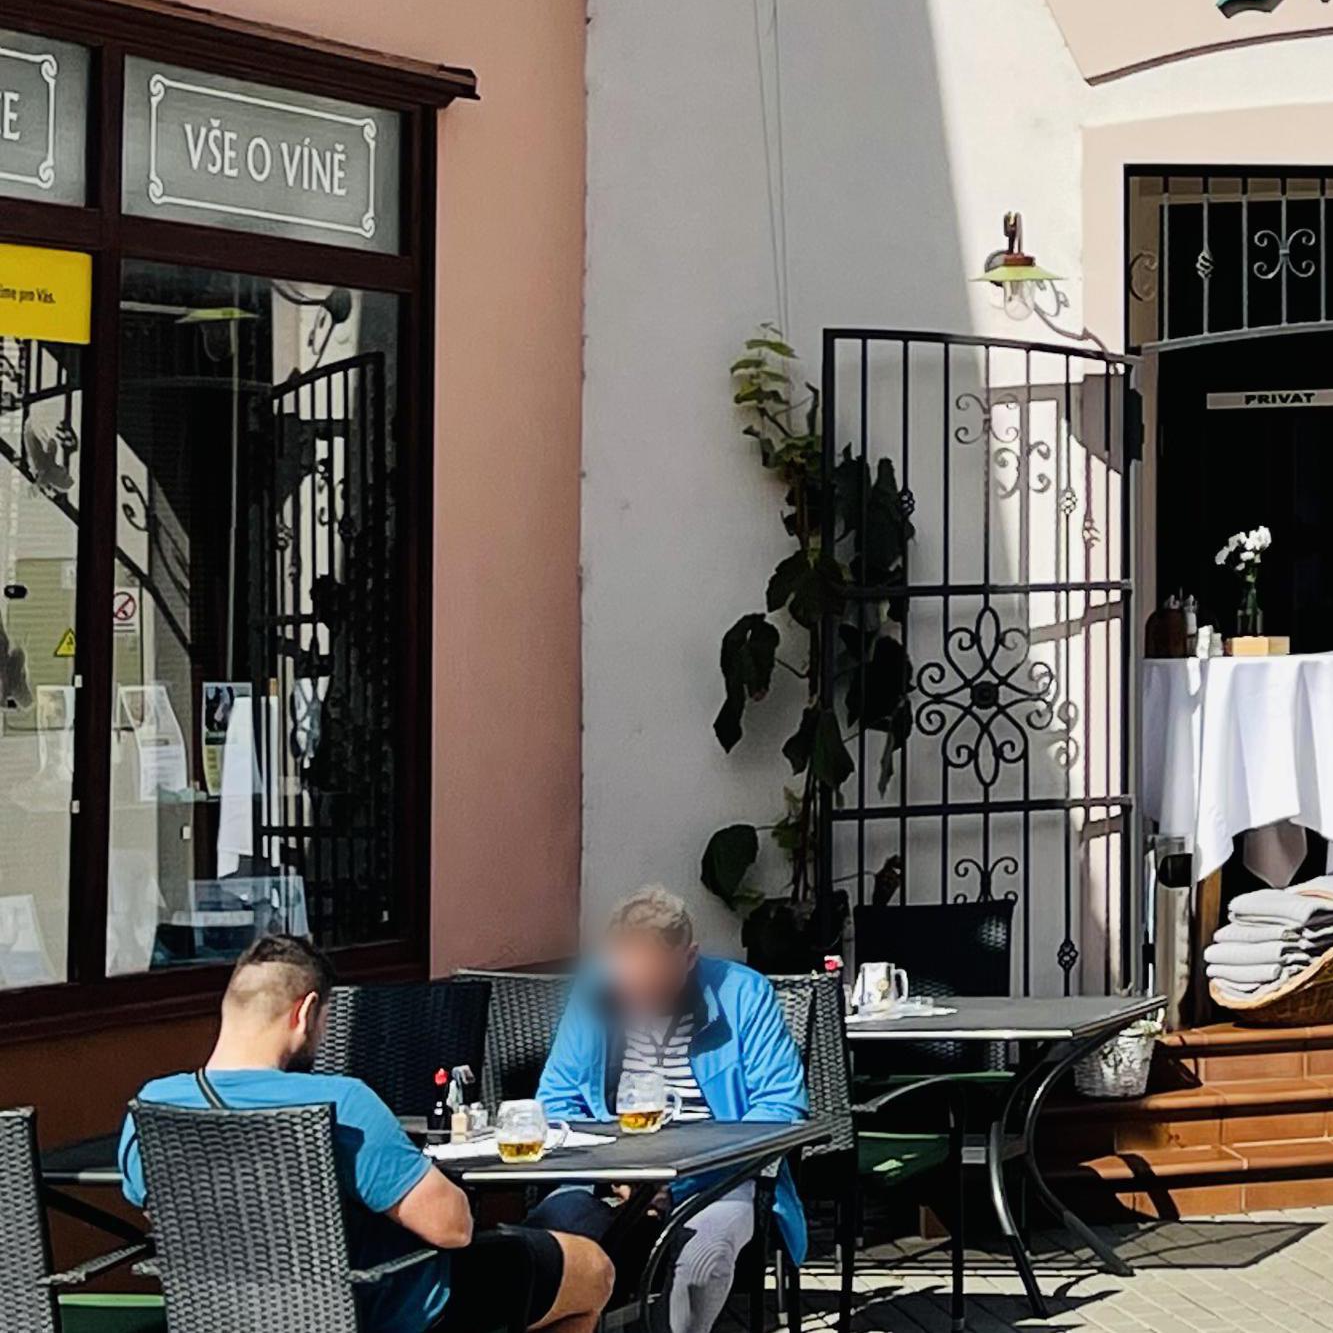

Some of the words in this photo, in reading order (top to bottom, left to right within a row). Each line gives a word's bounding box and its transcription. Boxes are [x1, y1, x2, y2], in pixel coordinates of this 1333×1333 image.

[183, 118, 239, 178] VŠE
[247, 136, 272, 183] O
[280, 137, 347, 196] VÍNĚ
[1244, 392, 1316, 406] PRIVAT
